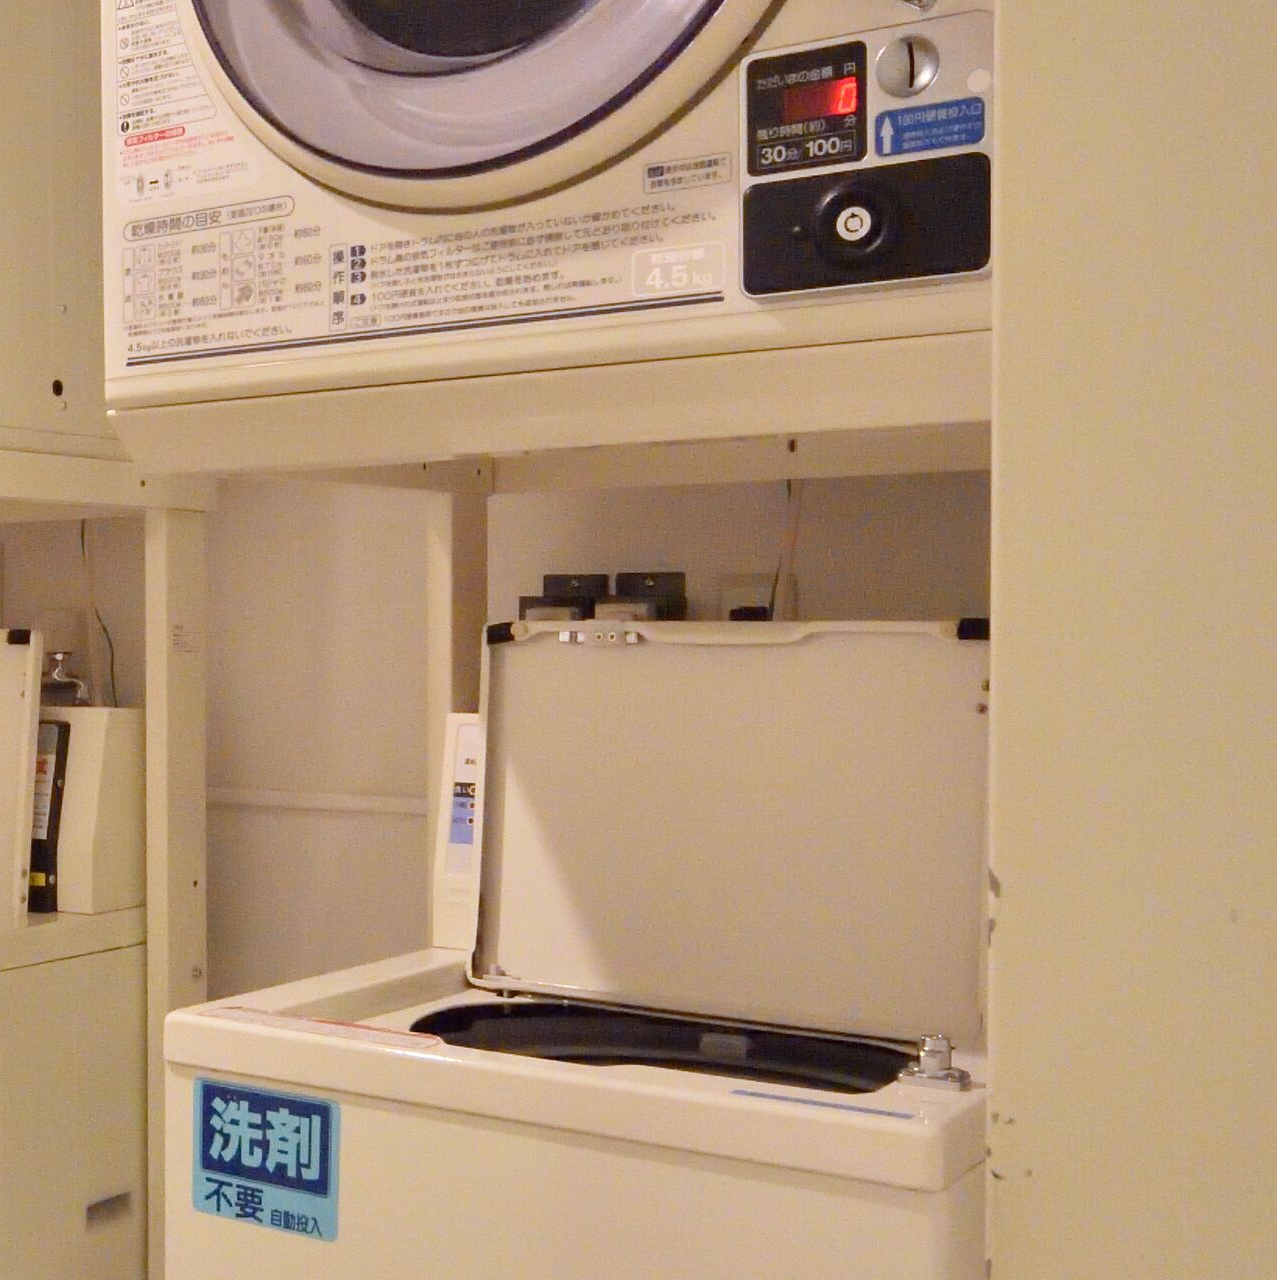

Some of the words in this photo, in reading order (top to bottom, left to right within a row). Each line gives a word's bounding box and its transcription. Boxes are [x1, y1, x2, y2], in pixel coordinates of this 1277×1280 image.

[843, 61, 856, 75] 円
[836, 81, 857, 115] 0
[844, 114, 857, 128] 分
[130, 210, 221, 237] 乾燥時間の目安
[332, 249, 345, 325] 操作順序
[209, 1096, 322, 1182] 洗剤
[204, 1176, 264, 1223] 不要
[270, 1209, 323, 1238] 自動投入
